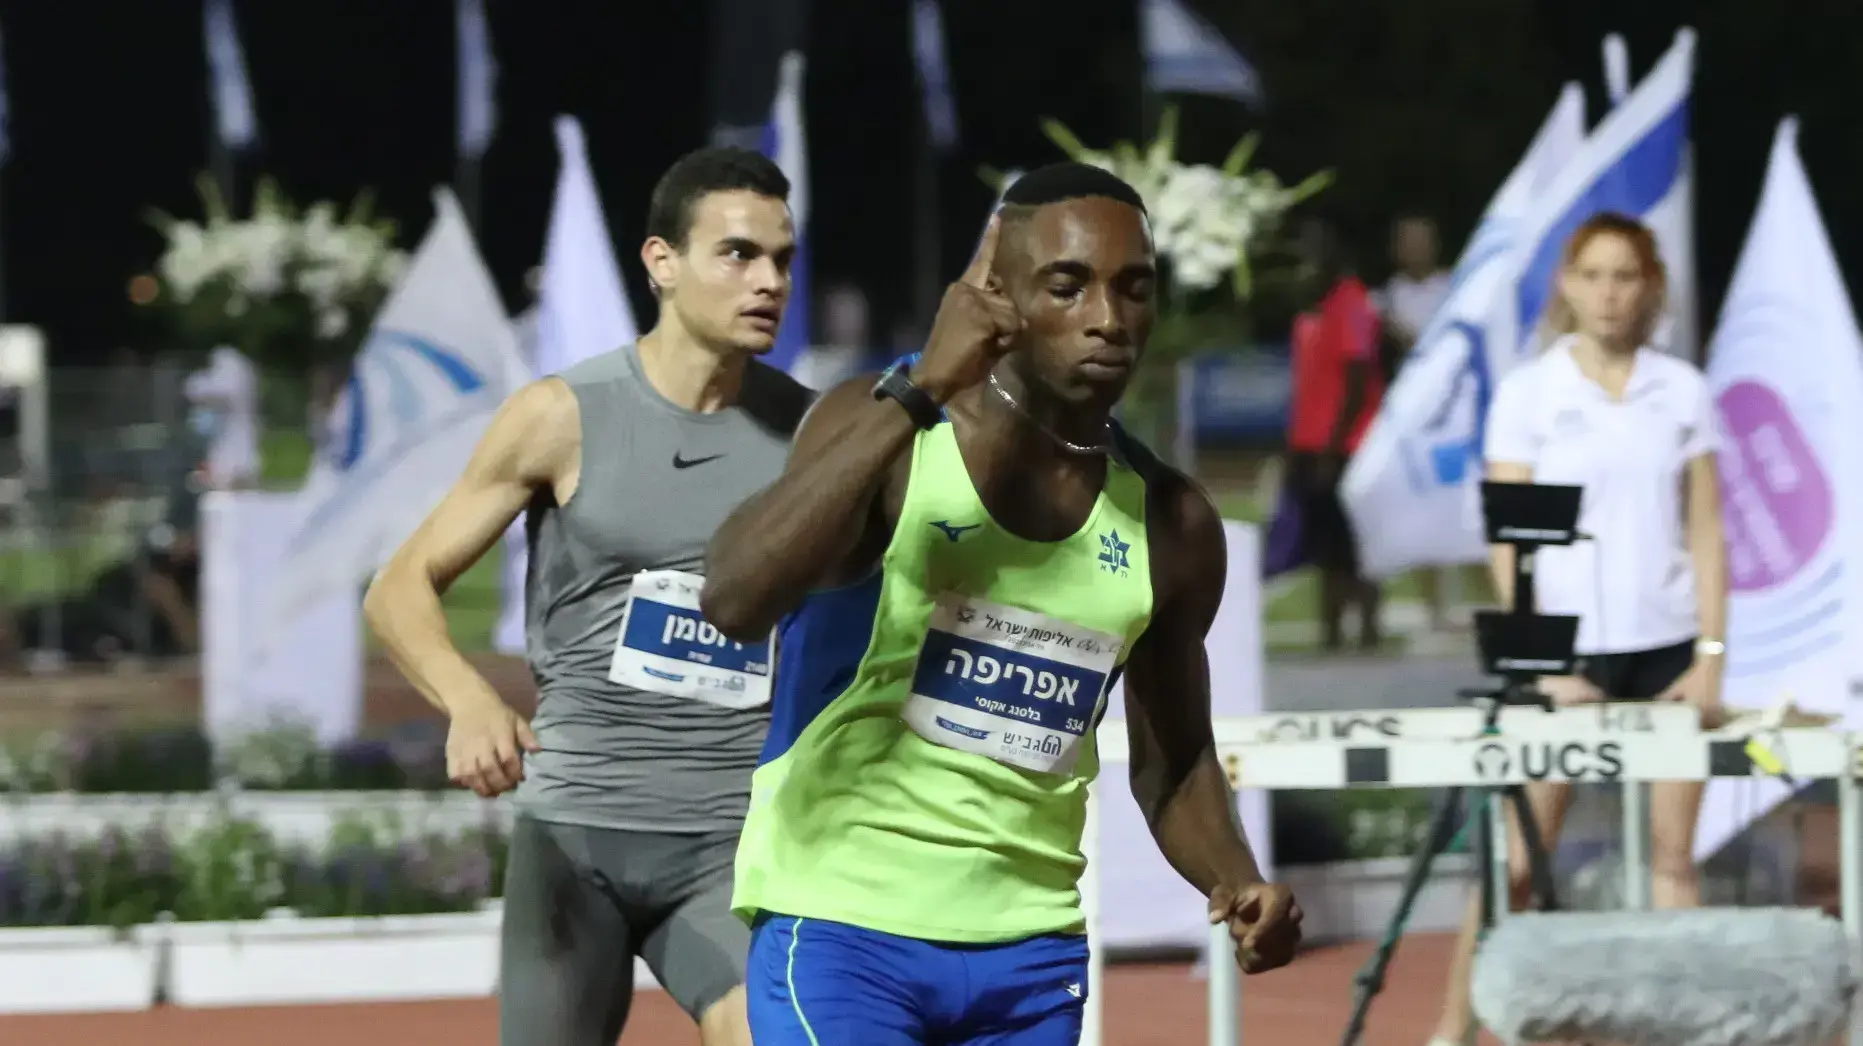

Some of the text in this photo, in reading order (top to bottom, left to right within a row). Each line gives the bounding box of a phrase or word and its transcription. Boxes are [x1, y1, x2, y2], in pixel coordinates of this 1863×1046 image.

[661, 613, 743, 651] וטמן
[985, 613, 1027, 636] ישראל
[1028, 626, 1074, 648] אליפות
[944, 647, 1080, 706] אפריפה
[975, 696, 1041, 722] בלסנג אקוסי
[1065, 717, 1084, 733] 534
[1521, 742, 1622, 780] UCS
